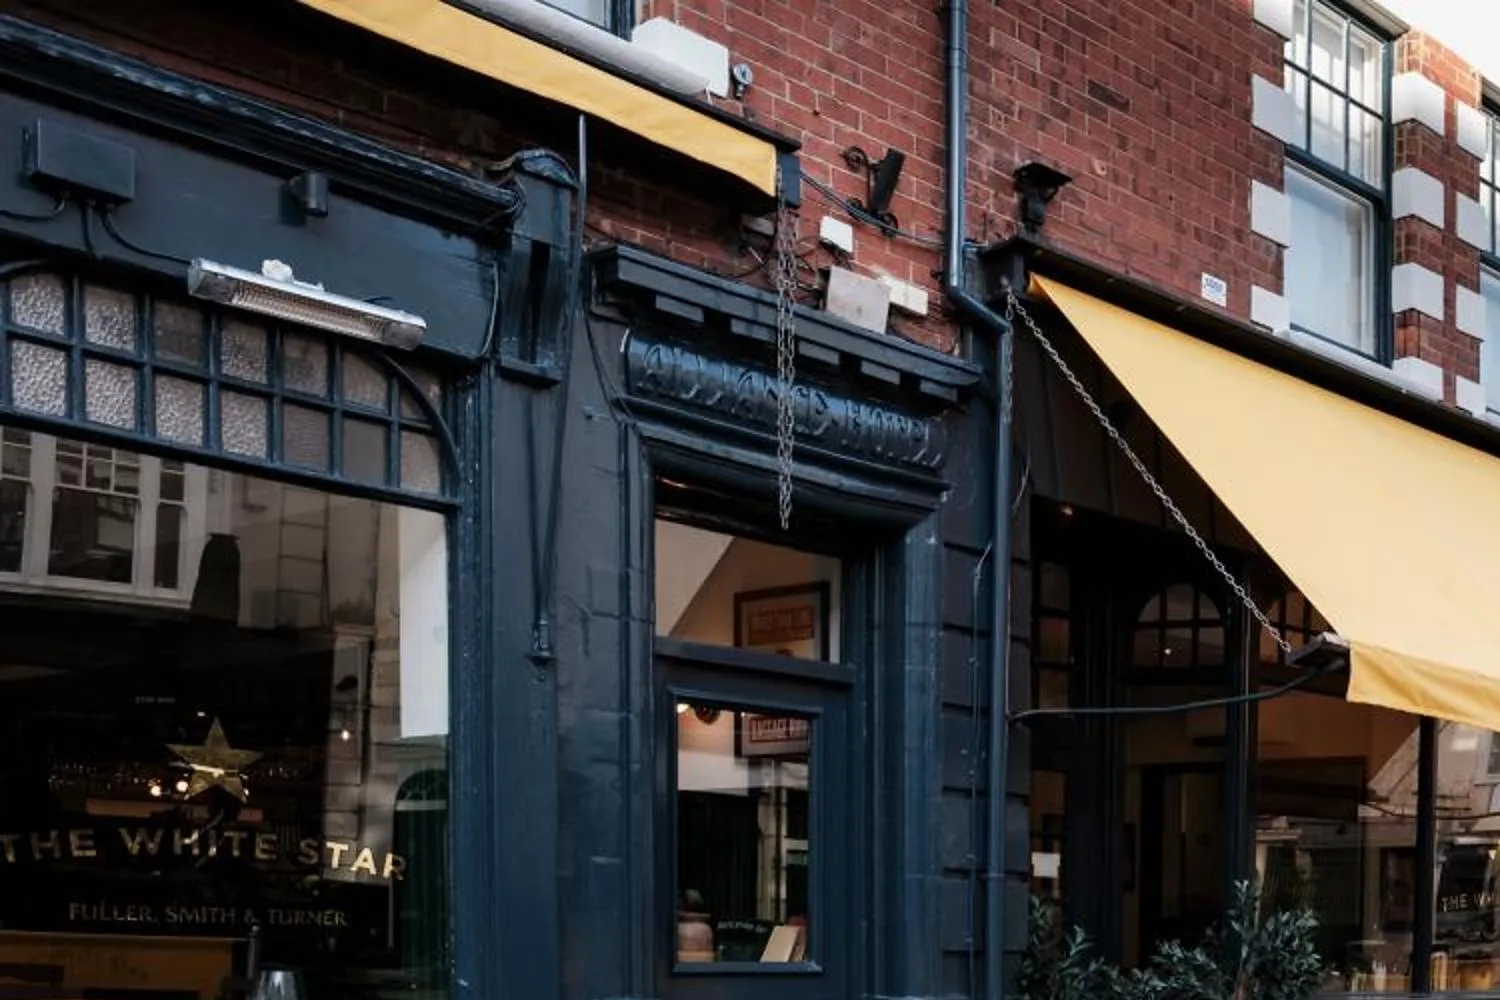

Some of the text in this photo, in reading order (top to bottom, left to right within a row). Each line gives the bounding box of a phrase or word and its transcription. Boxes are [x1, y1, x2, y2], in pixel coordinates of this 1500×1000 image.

[0, 827, 408, 881] THE WHITE STAR
[1441, 892, 1469, 913] THE
[165, 906, 236, 925] SMITH
[267, 908, 349, 927] TURNER
